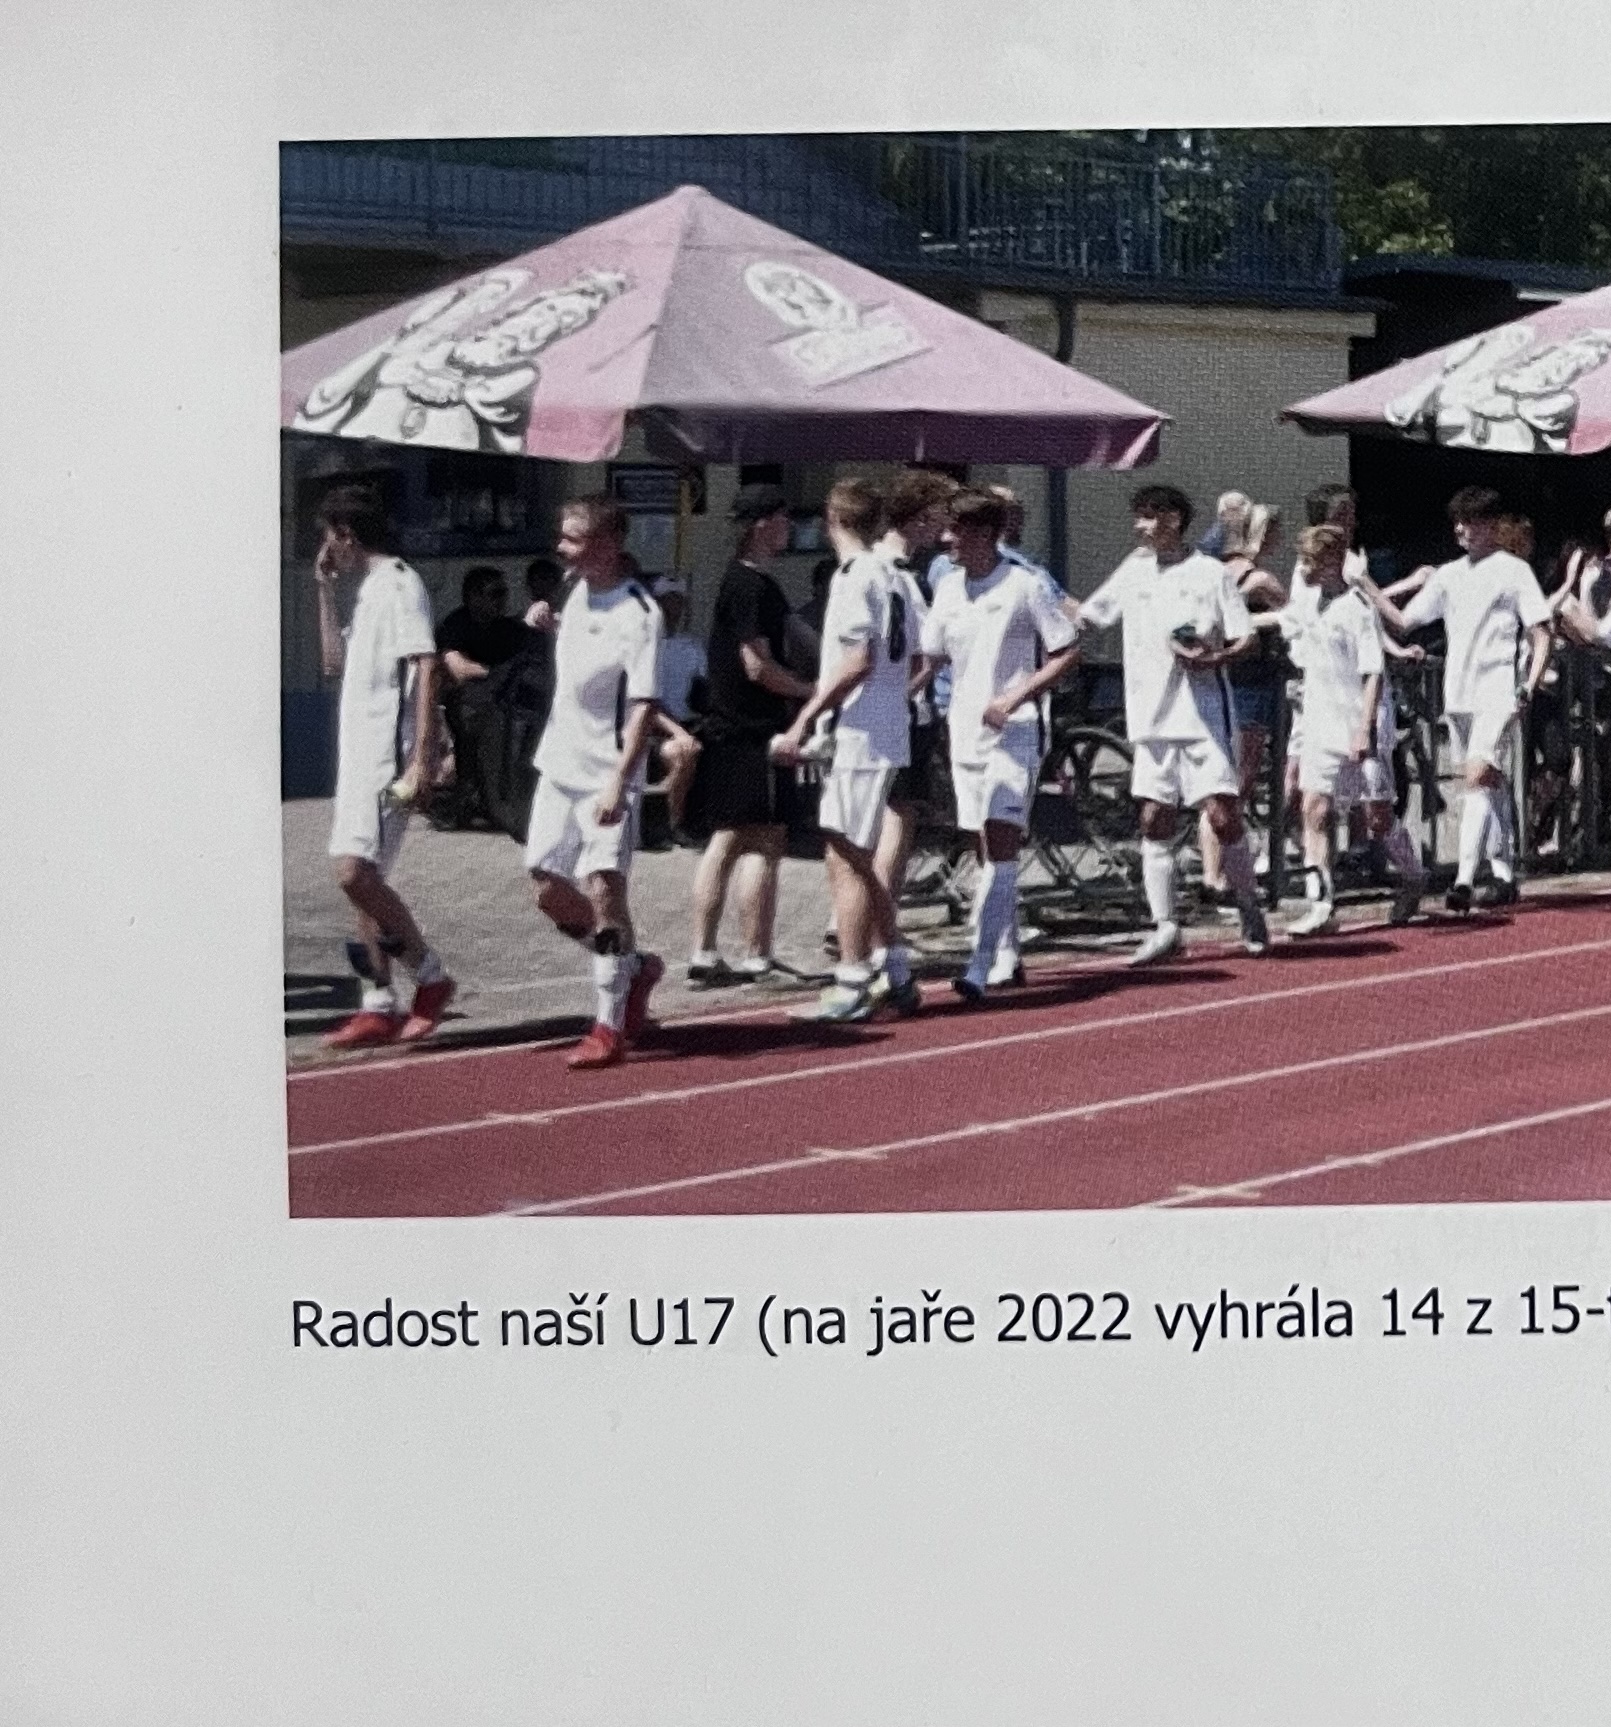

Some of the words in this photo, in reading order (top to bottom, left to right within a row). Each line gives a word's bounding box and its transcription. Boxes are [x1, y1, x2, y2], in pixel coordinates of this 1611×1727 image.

[291, 1296, 480, 1348] Radost
[501, 1292, 609, 1347] naší
[629, 1297, 735, 1346] U17
[758, 1293, 846, 1357] (na
[866, 1289, 975, 1357] jaře
[997, 1292, 1132, 1343] 2022
[1154, 1283, 1353, 1353] vyhrála
[1382, 1287, 1445, 1337] 14
[1466, 1298, 1493, 1335] z
